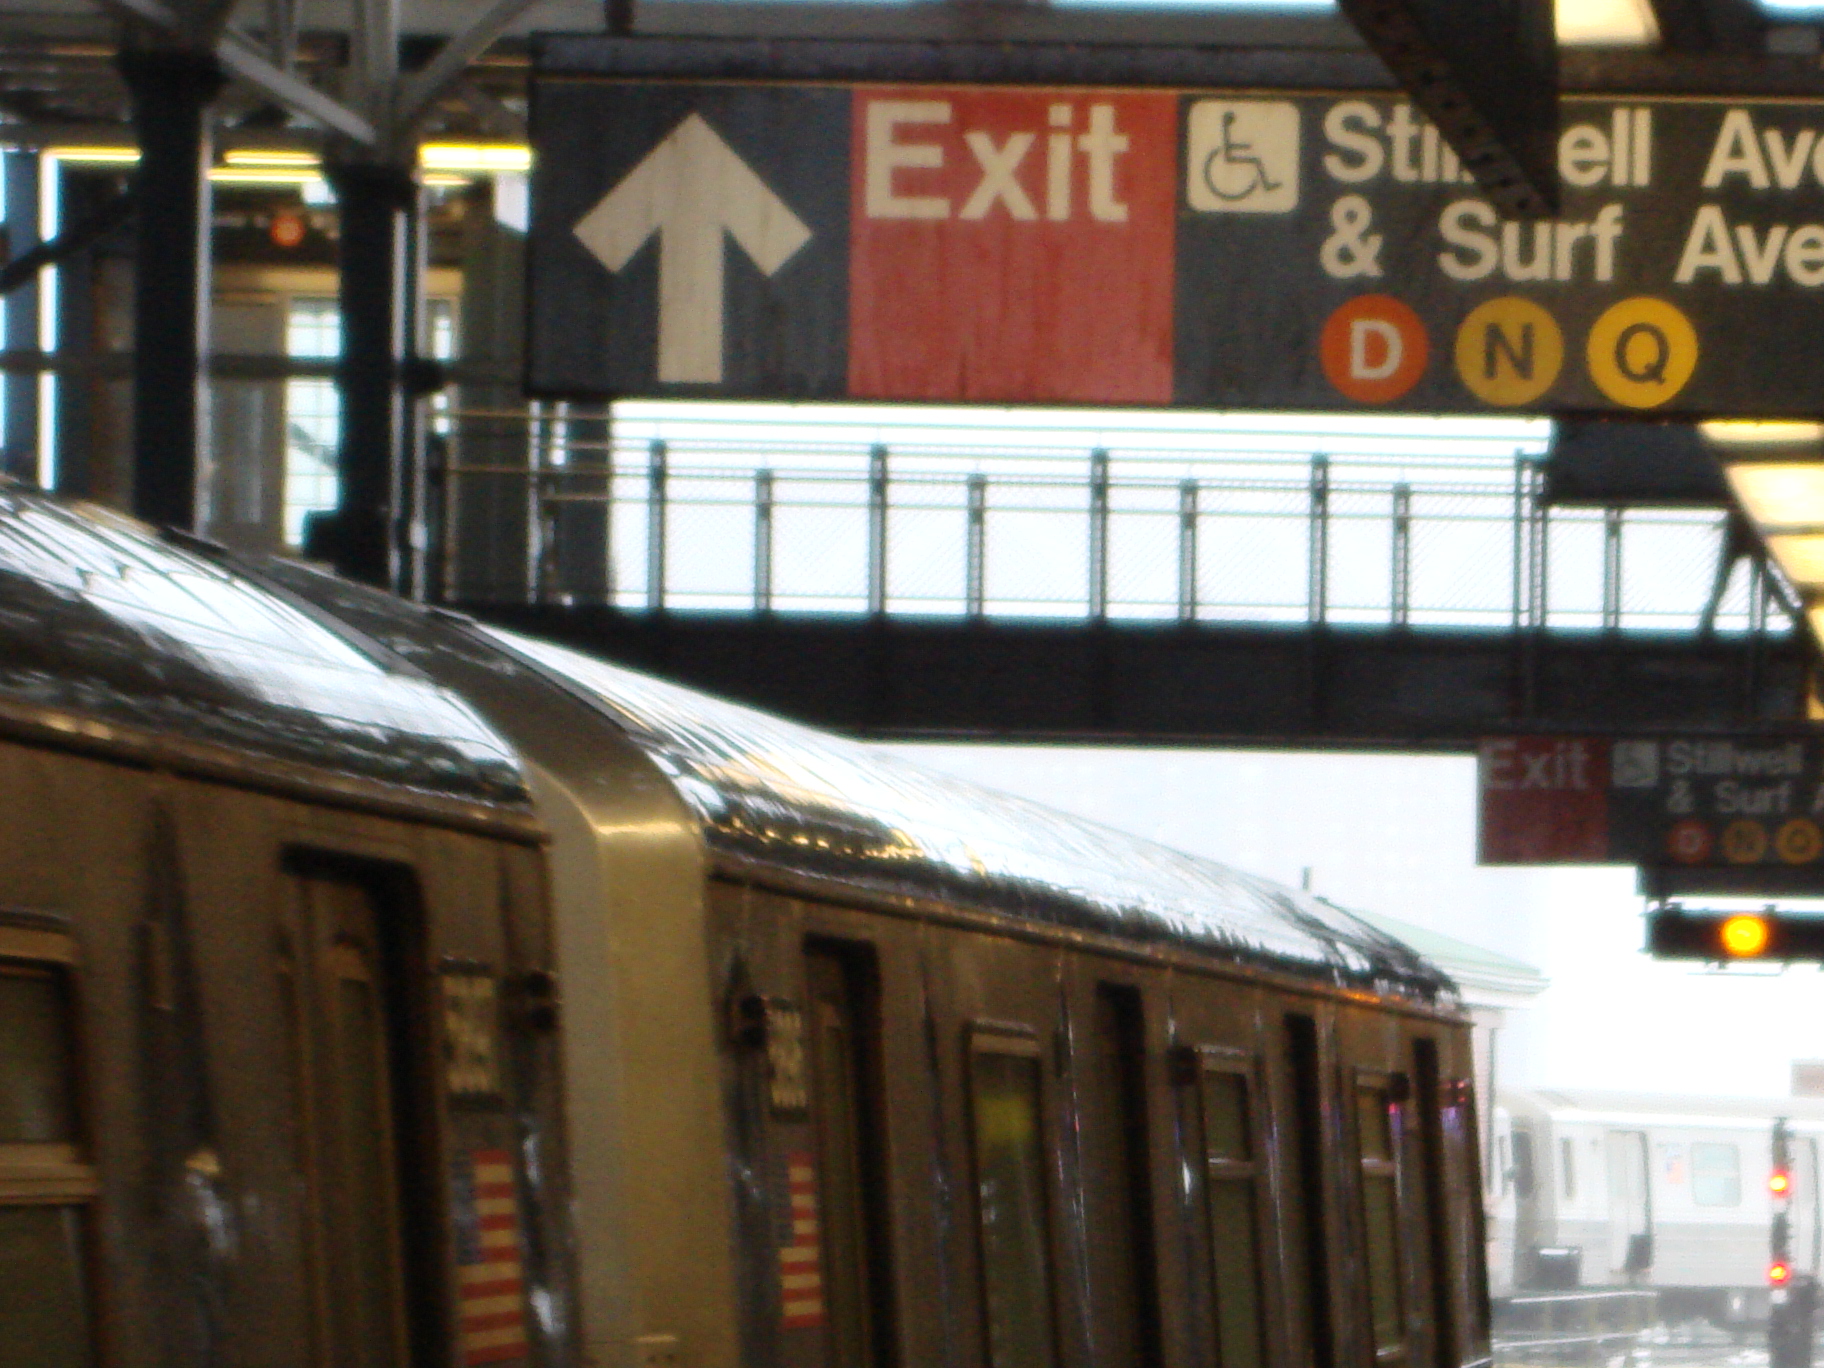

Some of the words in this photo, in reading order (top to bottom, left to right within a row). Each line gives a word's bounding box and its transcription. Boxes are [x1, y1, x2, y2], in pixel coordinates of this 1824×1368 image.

[862, 101, 1130, 224] Exit
[1322, 98, 1655, 189] Stiell
[1320, 194, 1383, 279] &
[1438, 199, 1625, 283] Surf
[1350, 319, 1402, 380] D
[1484, 322, 1535, 381] N
[1614, 322, 1669, 386] Q
[1482, 740, 1588, 789] Exit
[1712, 779, 1792, 815] Surf
